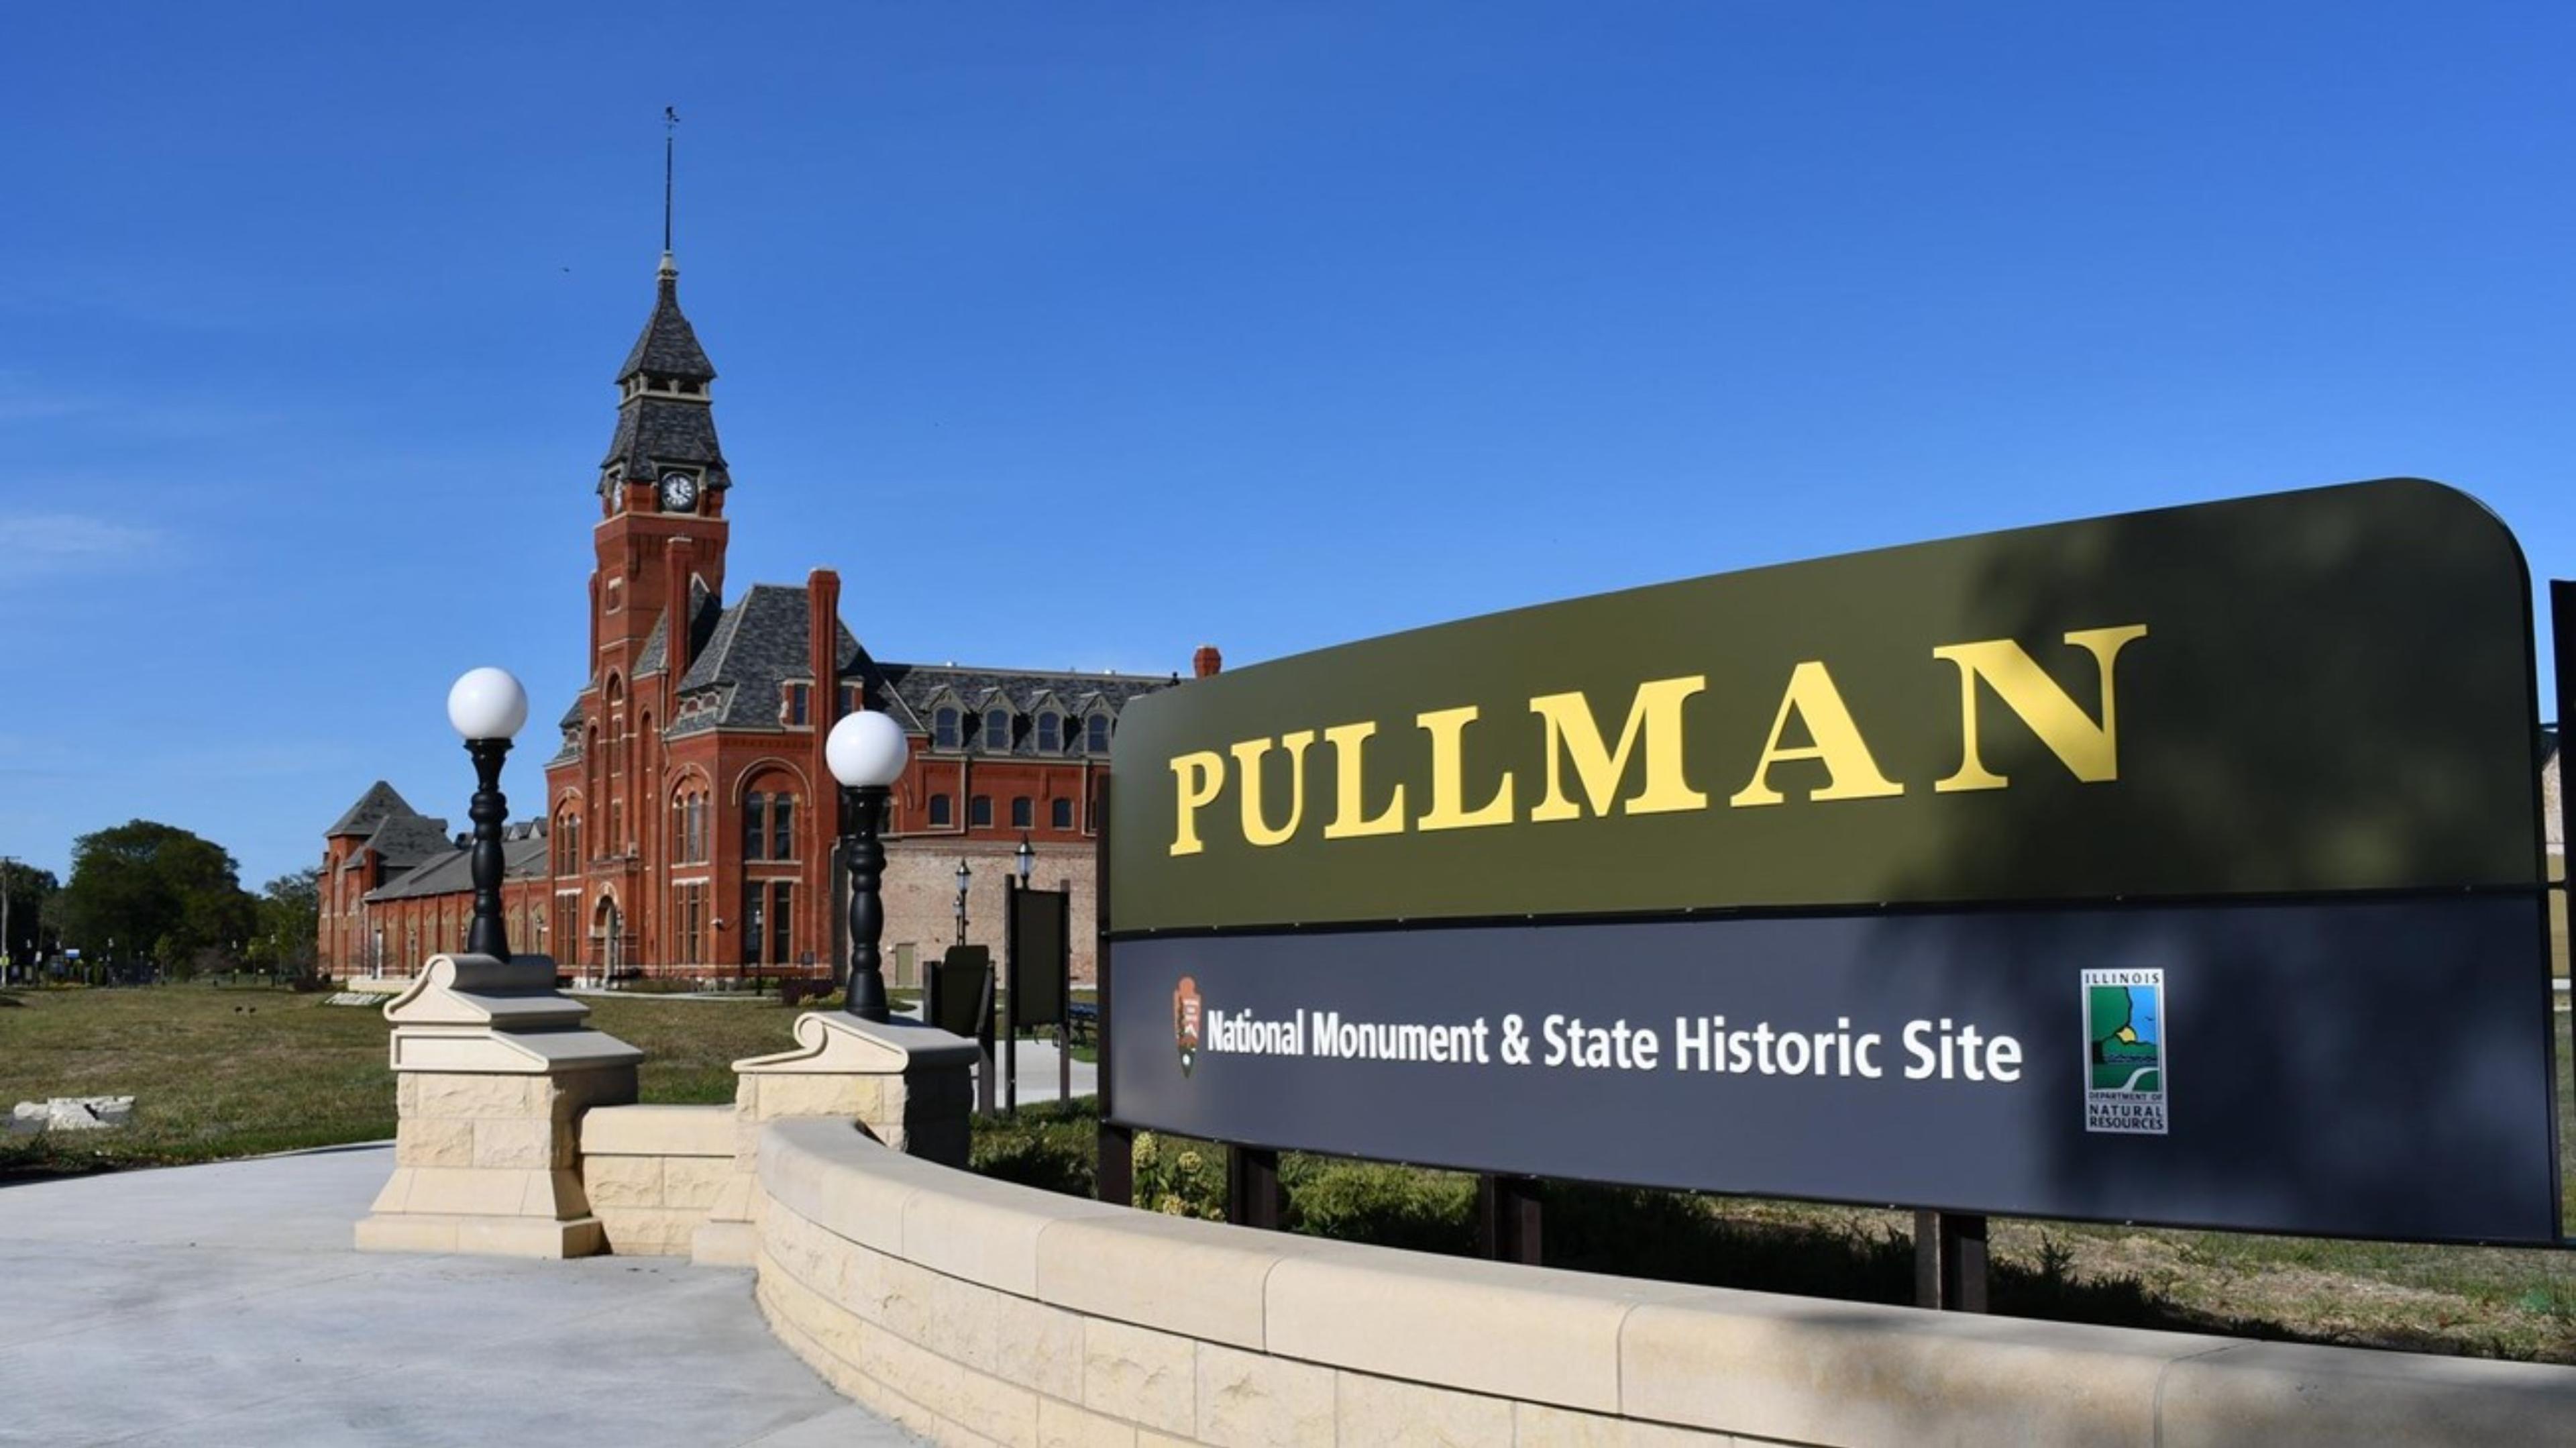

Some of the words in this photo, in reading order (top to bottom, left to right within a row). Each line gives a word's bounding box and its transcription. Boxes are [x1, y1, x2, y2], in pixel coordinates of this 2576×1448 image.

[1170, 625, 2147, 857] PULLMAN
[2085, 972, 2159, 984] ILLINOIS
[1208, 1008, 1305, 1055] National
[1312, 1011, 1490, 1064] Monument
[1501, 1013, 1532, 1065] &
[1543, 1014, 1659, 1070] State
[1676, 1015, 1882, 1078] Historic
[1902, 1018, 2023, 1082] Site
[2089, 1092, 2147, 1100] DEPARTMENT
[2090, 1104, 2162, 1117] NATURAL
[2090, 1116, 2163, 1130] RESOURCES
